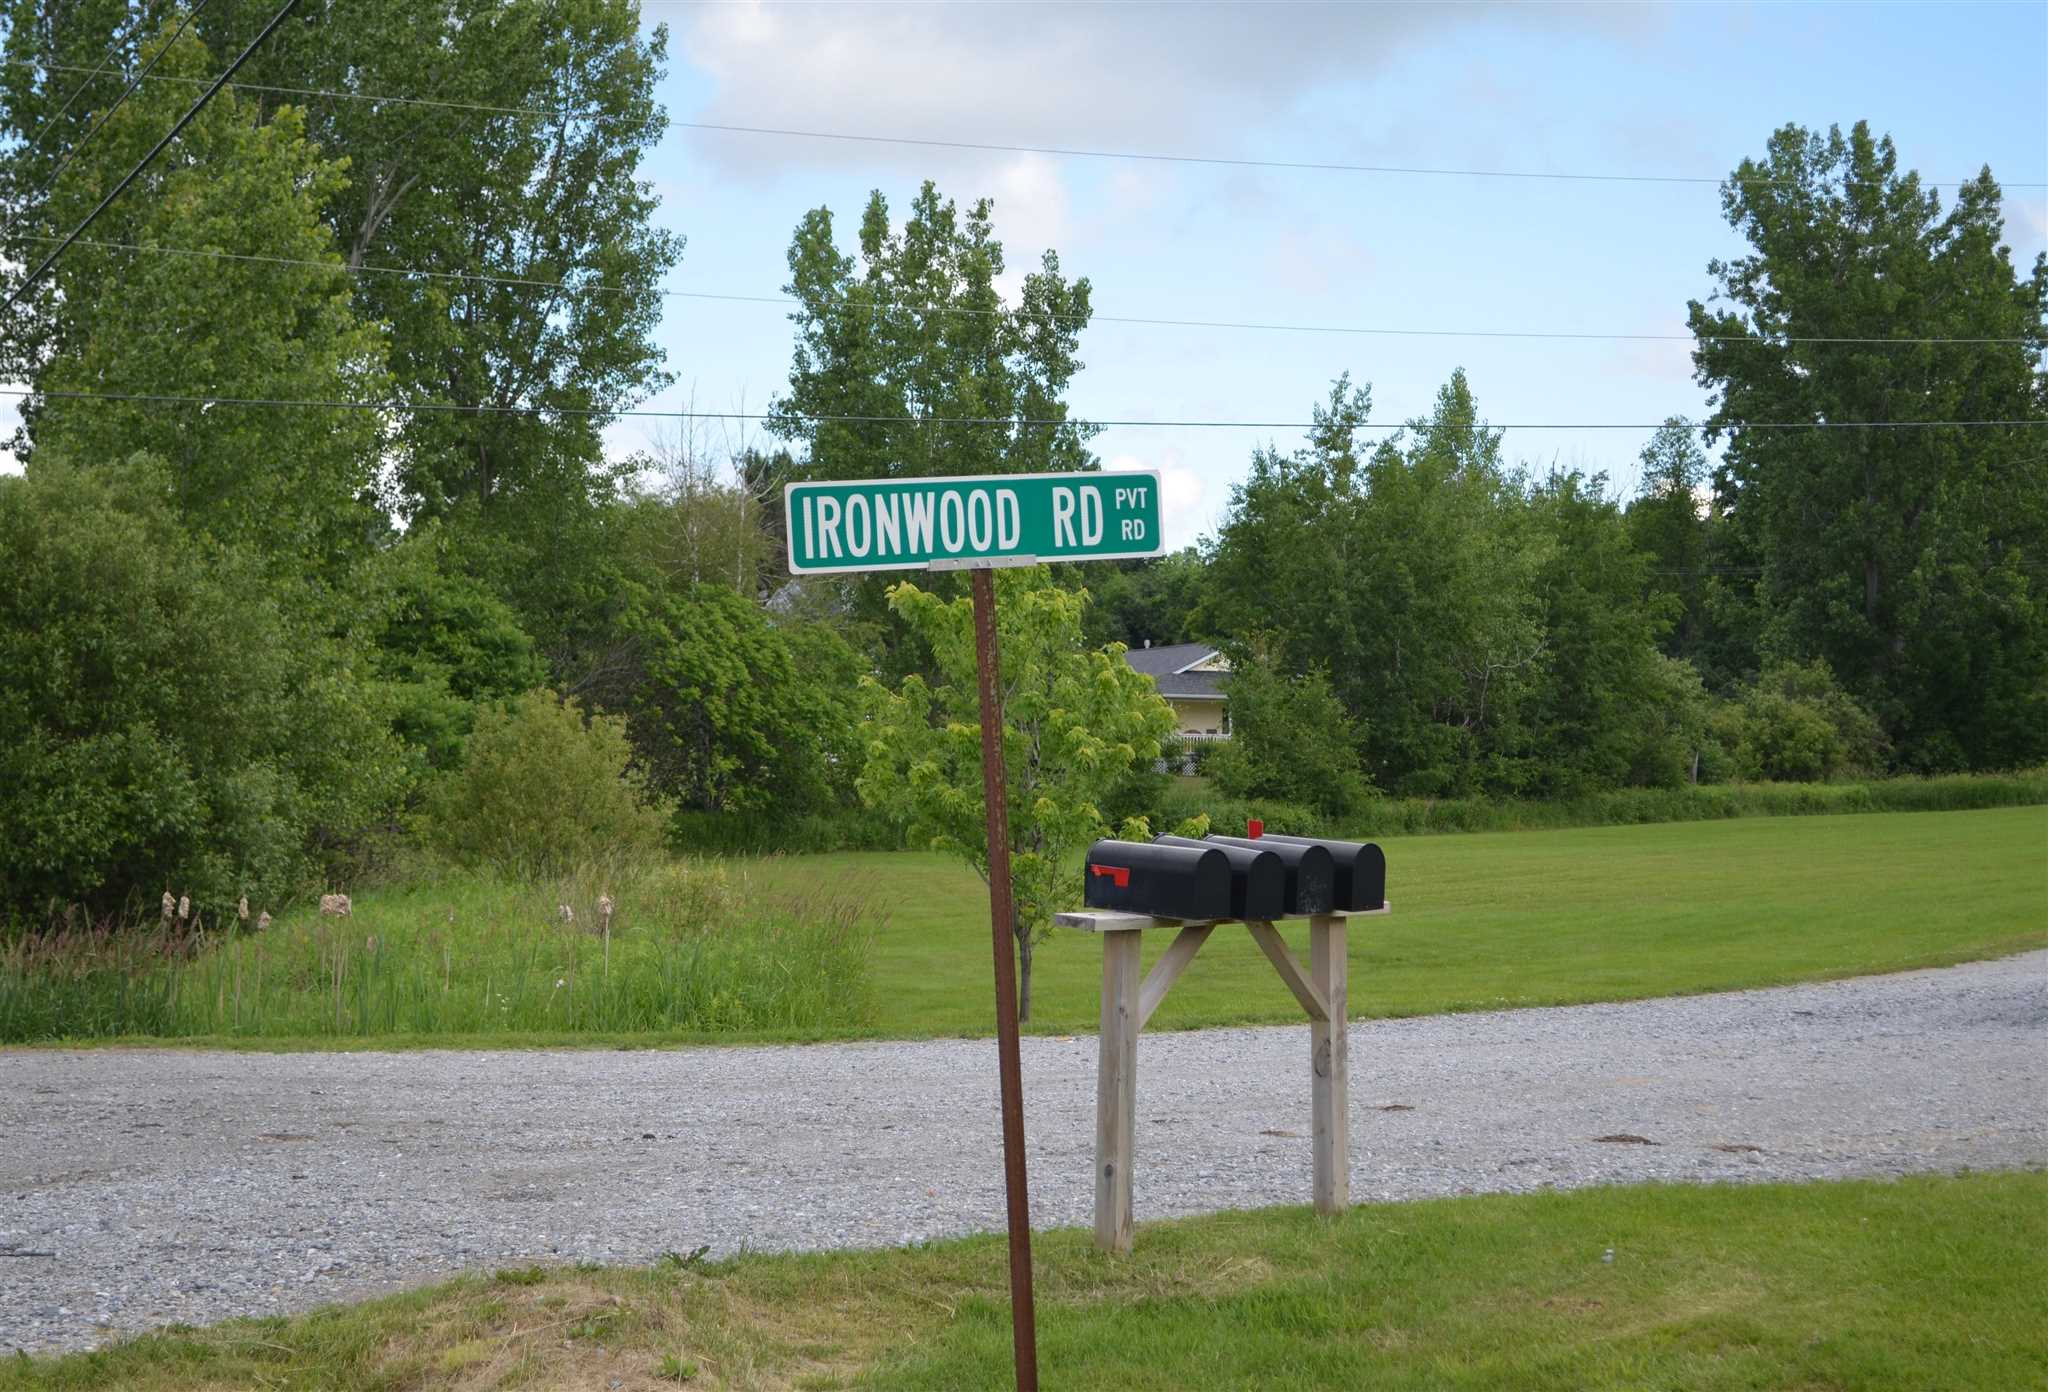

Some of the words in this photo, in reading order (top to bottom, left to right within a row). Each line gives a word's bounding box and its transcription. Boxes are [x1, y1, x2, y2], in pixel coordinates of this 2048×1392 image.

[1115, 487, 1147, 510] PVT
[802, 488, 1020, 560] IRONWOOD
[1052, 485, 1104, 548] RD
[1121, 518, 1145, 541] RD
